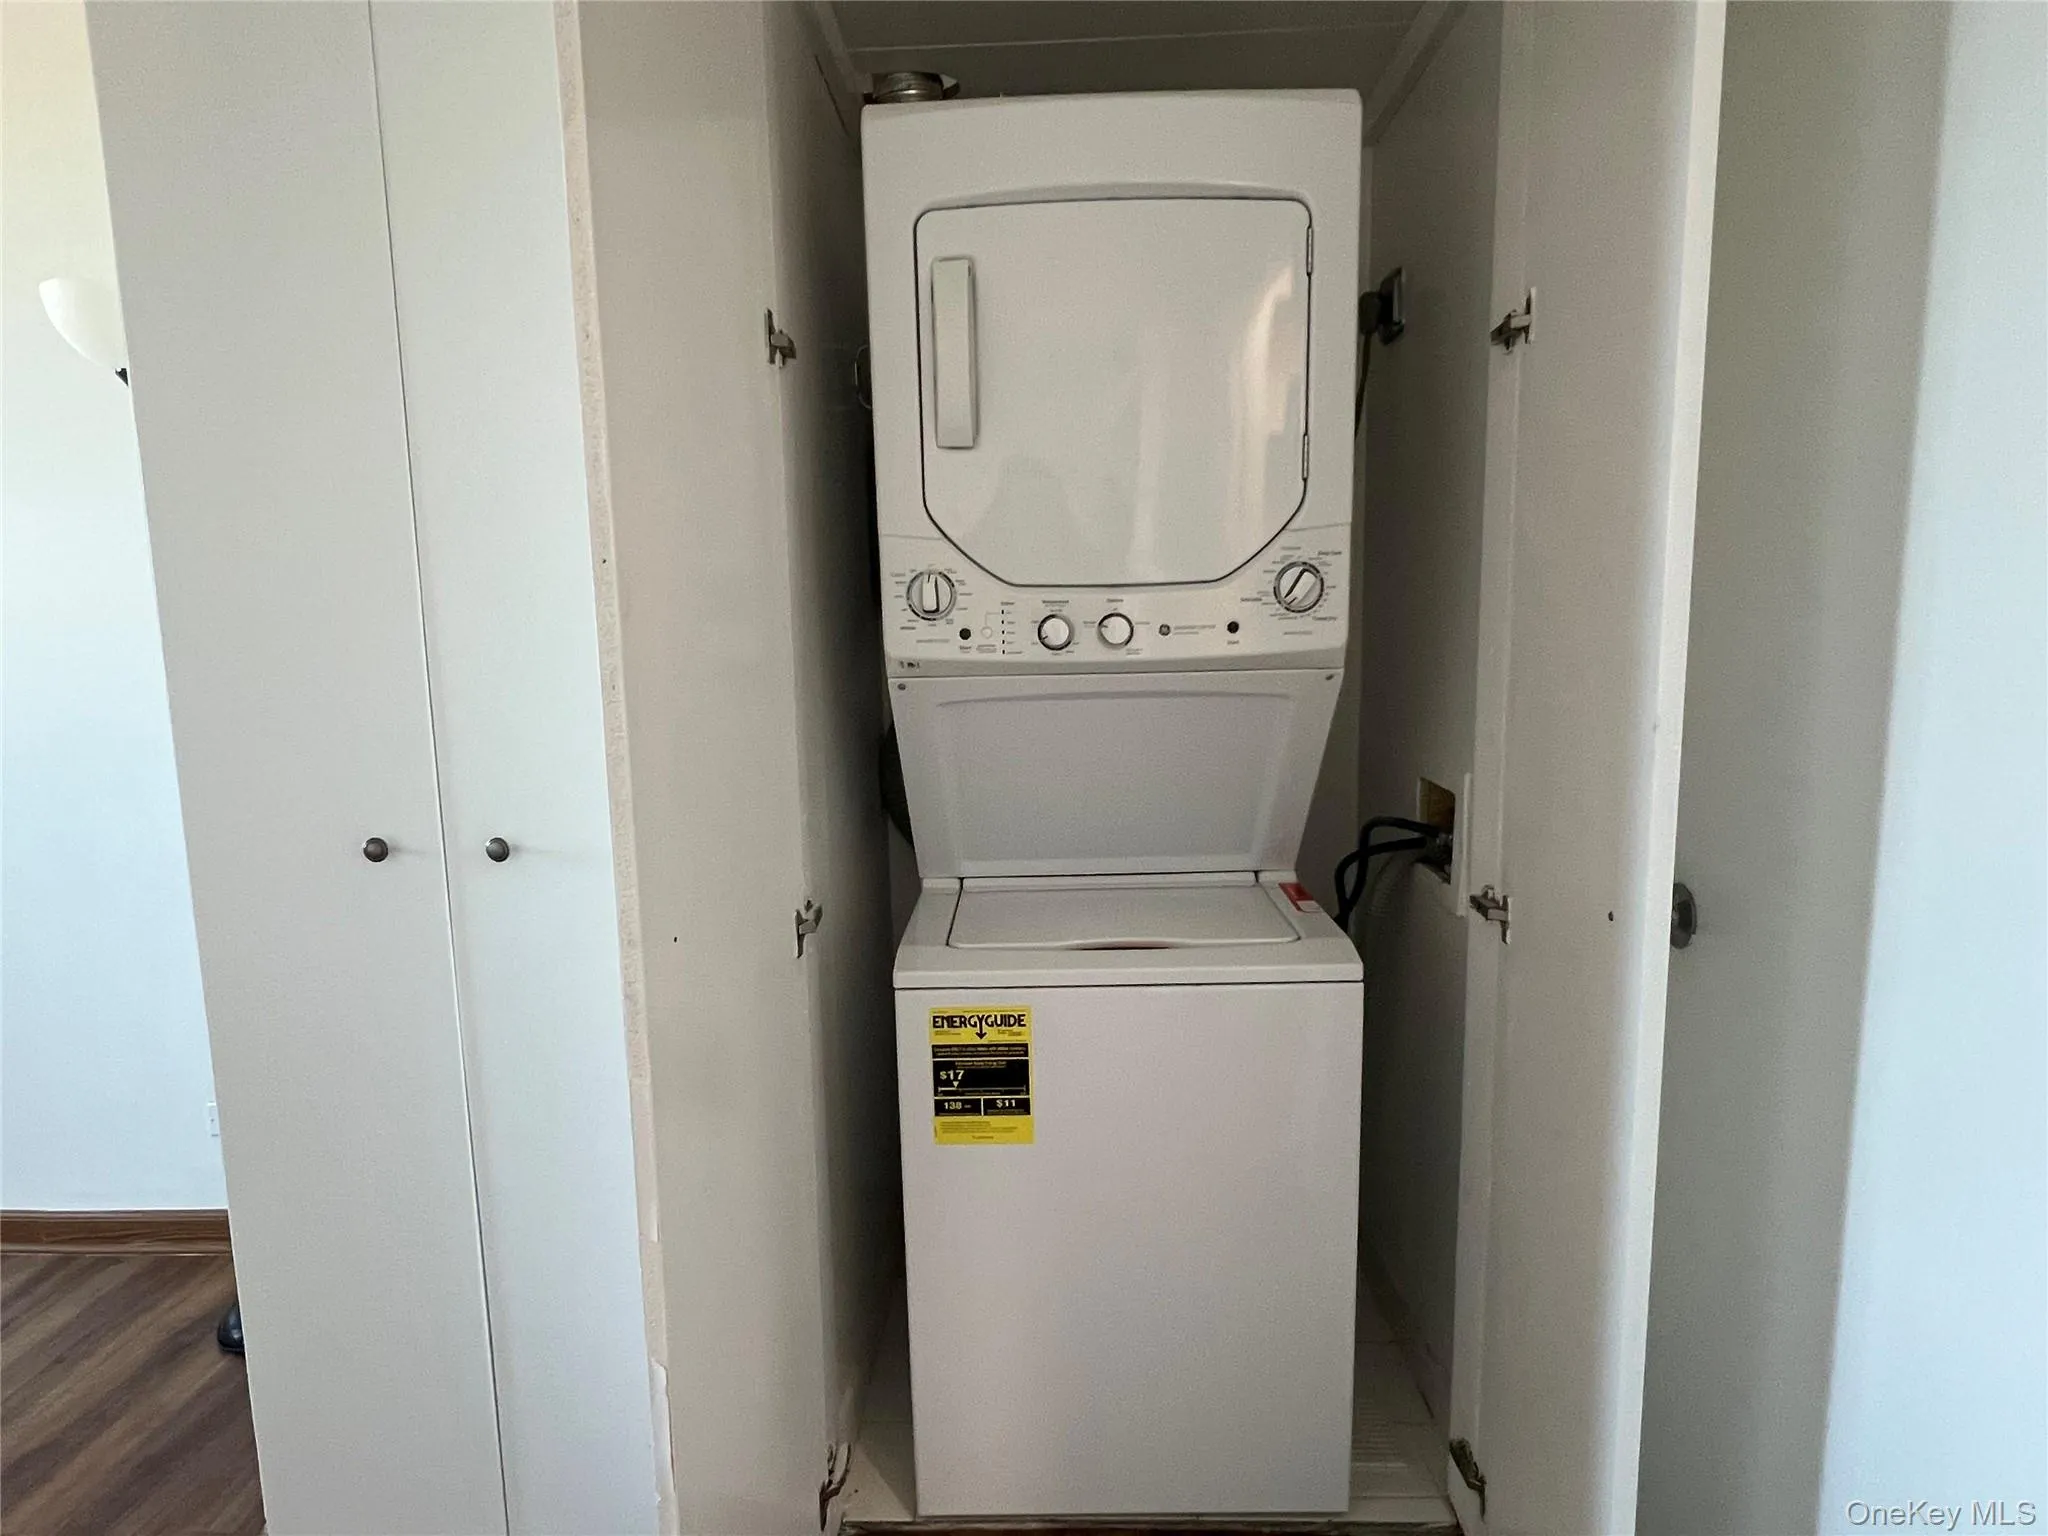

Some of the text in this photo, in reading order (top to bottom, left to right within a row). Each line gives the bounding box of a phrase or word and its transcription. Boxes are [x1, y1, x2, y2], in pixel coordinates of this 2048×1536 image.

[932, 1013, 1027, 1031] ENERGYGUIDE
[939, 1069, 965, 1081] $17
[943, 1101, 962, 1110] 138
[996, 1098, 1016, 1108] $11
